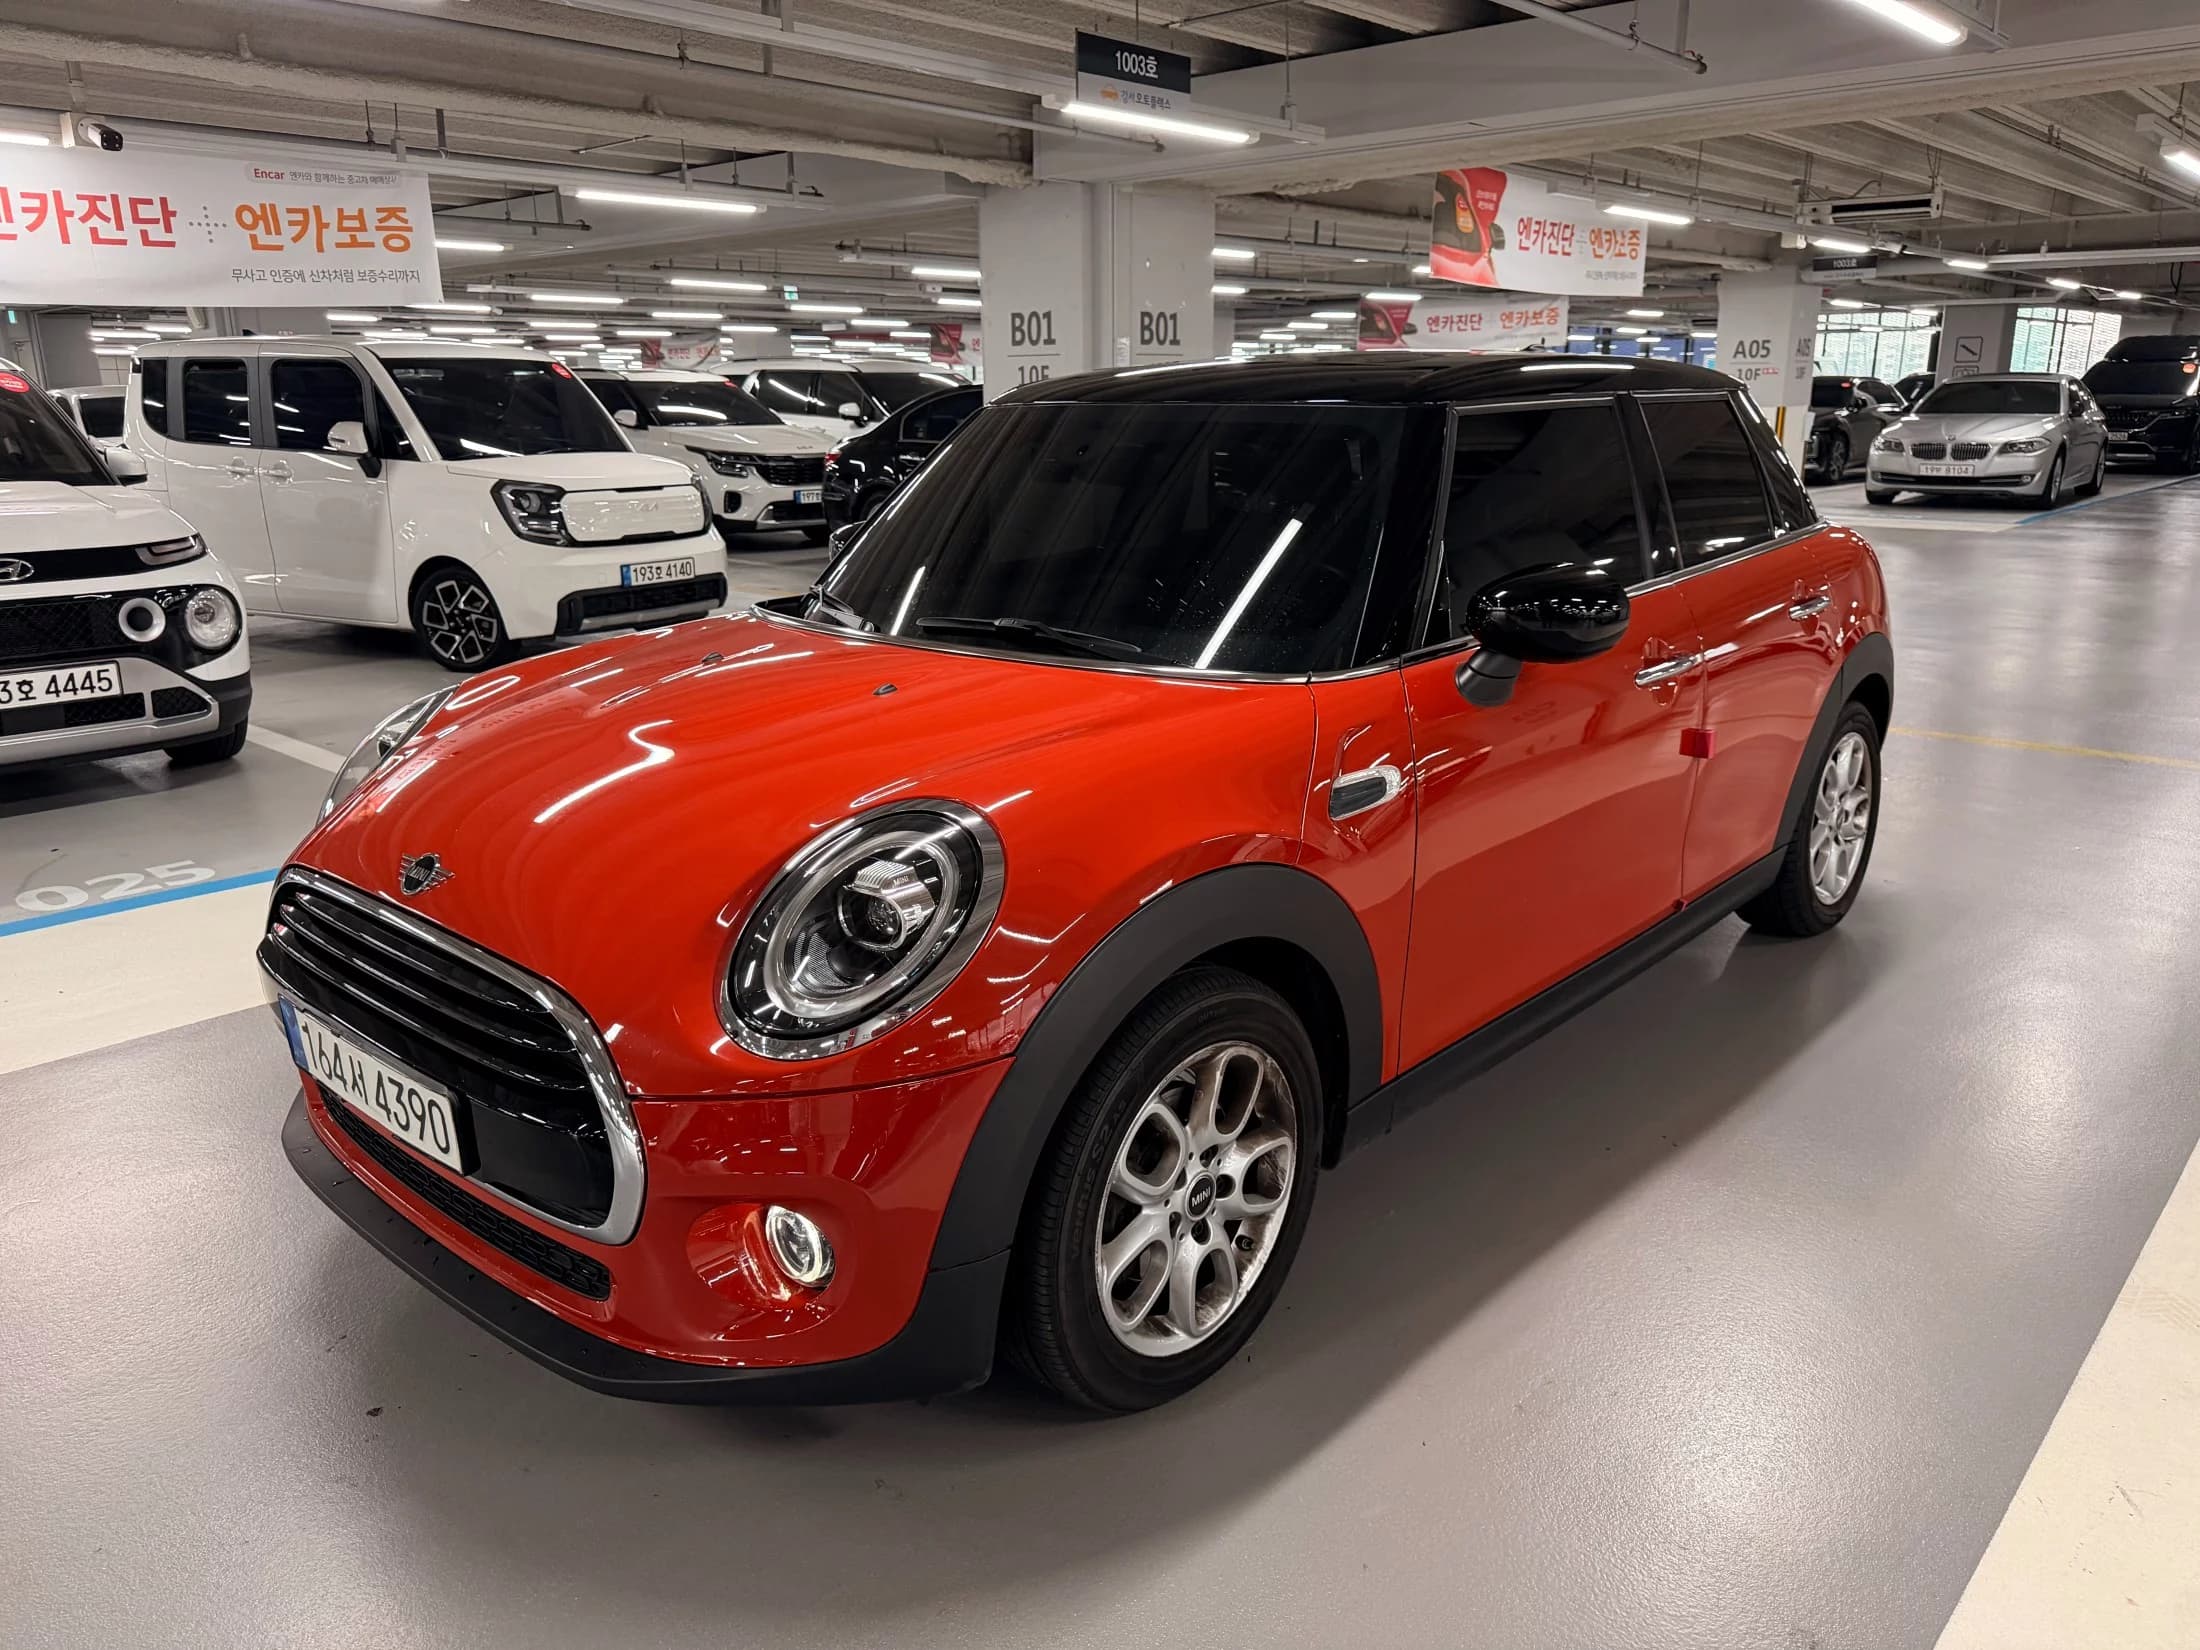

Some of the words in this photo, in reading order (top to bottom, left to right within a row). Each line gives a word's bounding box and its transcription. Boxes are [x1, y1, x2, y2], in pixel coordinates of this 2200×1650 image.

[1115, 50, 1159, 79] 1003호
[254, 168, 285, 180] Encar
[314, 172, 345, 184] 함께하는
[235, 203, 414, 253] 엔카보증
[1517, 216, 1575, 257] 엔카진단
[232, 268, 267, 283] 무사고
[269, 269, 306, 283] 인증에
[310, 269, 354, 283] 신차처럼
[357, 269, 421, 283] 보증수리까지
[1010, 310, 1056, 346] B01
[1139, 311, 1181, 346] B01
[1426, 313, 1483, 333] 엔카진단
[1500, 306, 1560, 329] 엔카보증
[1732, 339, 1771, 359] A05
[1737, 368, 1761, 381] 10F
[632, 565, 664, 583] 193호
[665, 561, 692, 578] 4140
[45, 668, 113, 698] 4445
[15, 859, 216, 912] 025
[302, 1021, 369, 1106] 164서
[375, 1070, 451, 1156] 4390
[1191, 1186, 1211, 1207] MINI
